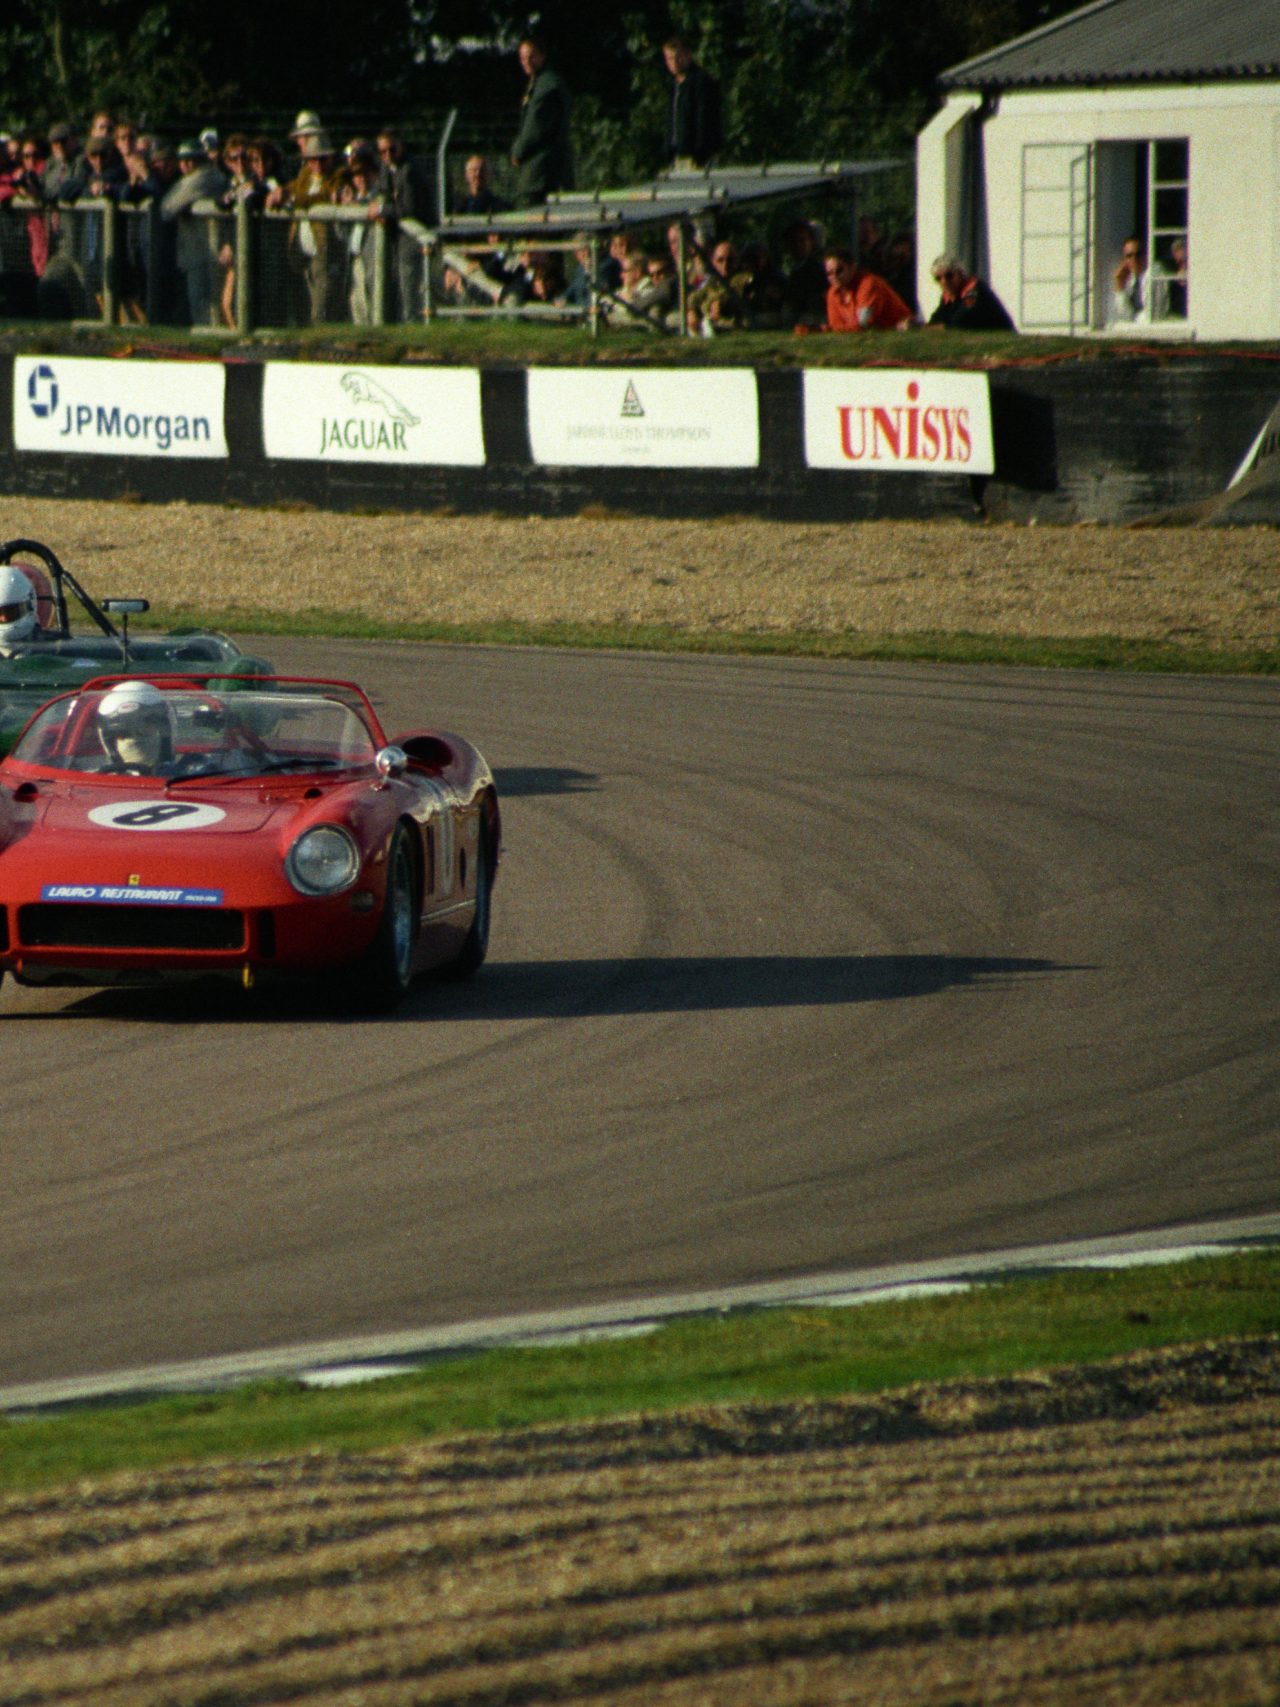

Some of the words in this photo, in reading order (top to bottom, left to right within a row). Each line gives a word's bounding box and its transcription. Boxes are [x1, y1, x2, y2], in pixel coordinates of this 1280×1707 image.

[60, 404, 211, 450] JPMorgan
[320, 417, 408, 455] JAGUAR
[112, 804, 200, 826] 8
[100, 887, 184, 901] RESTAURANT
